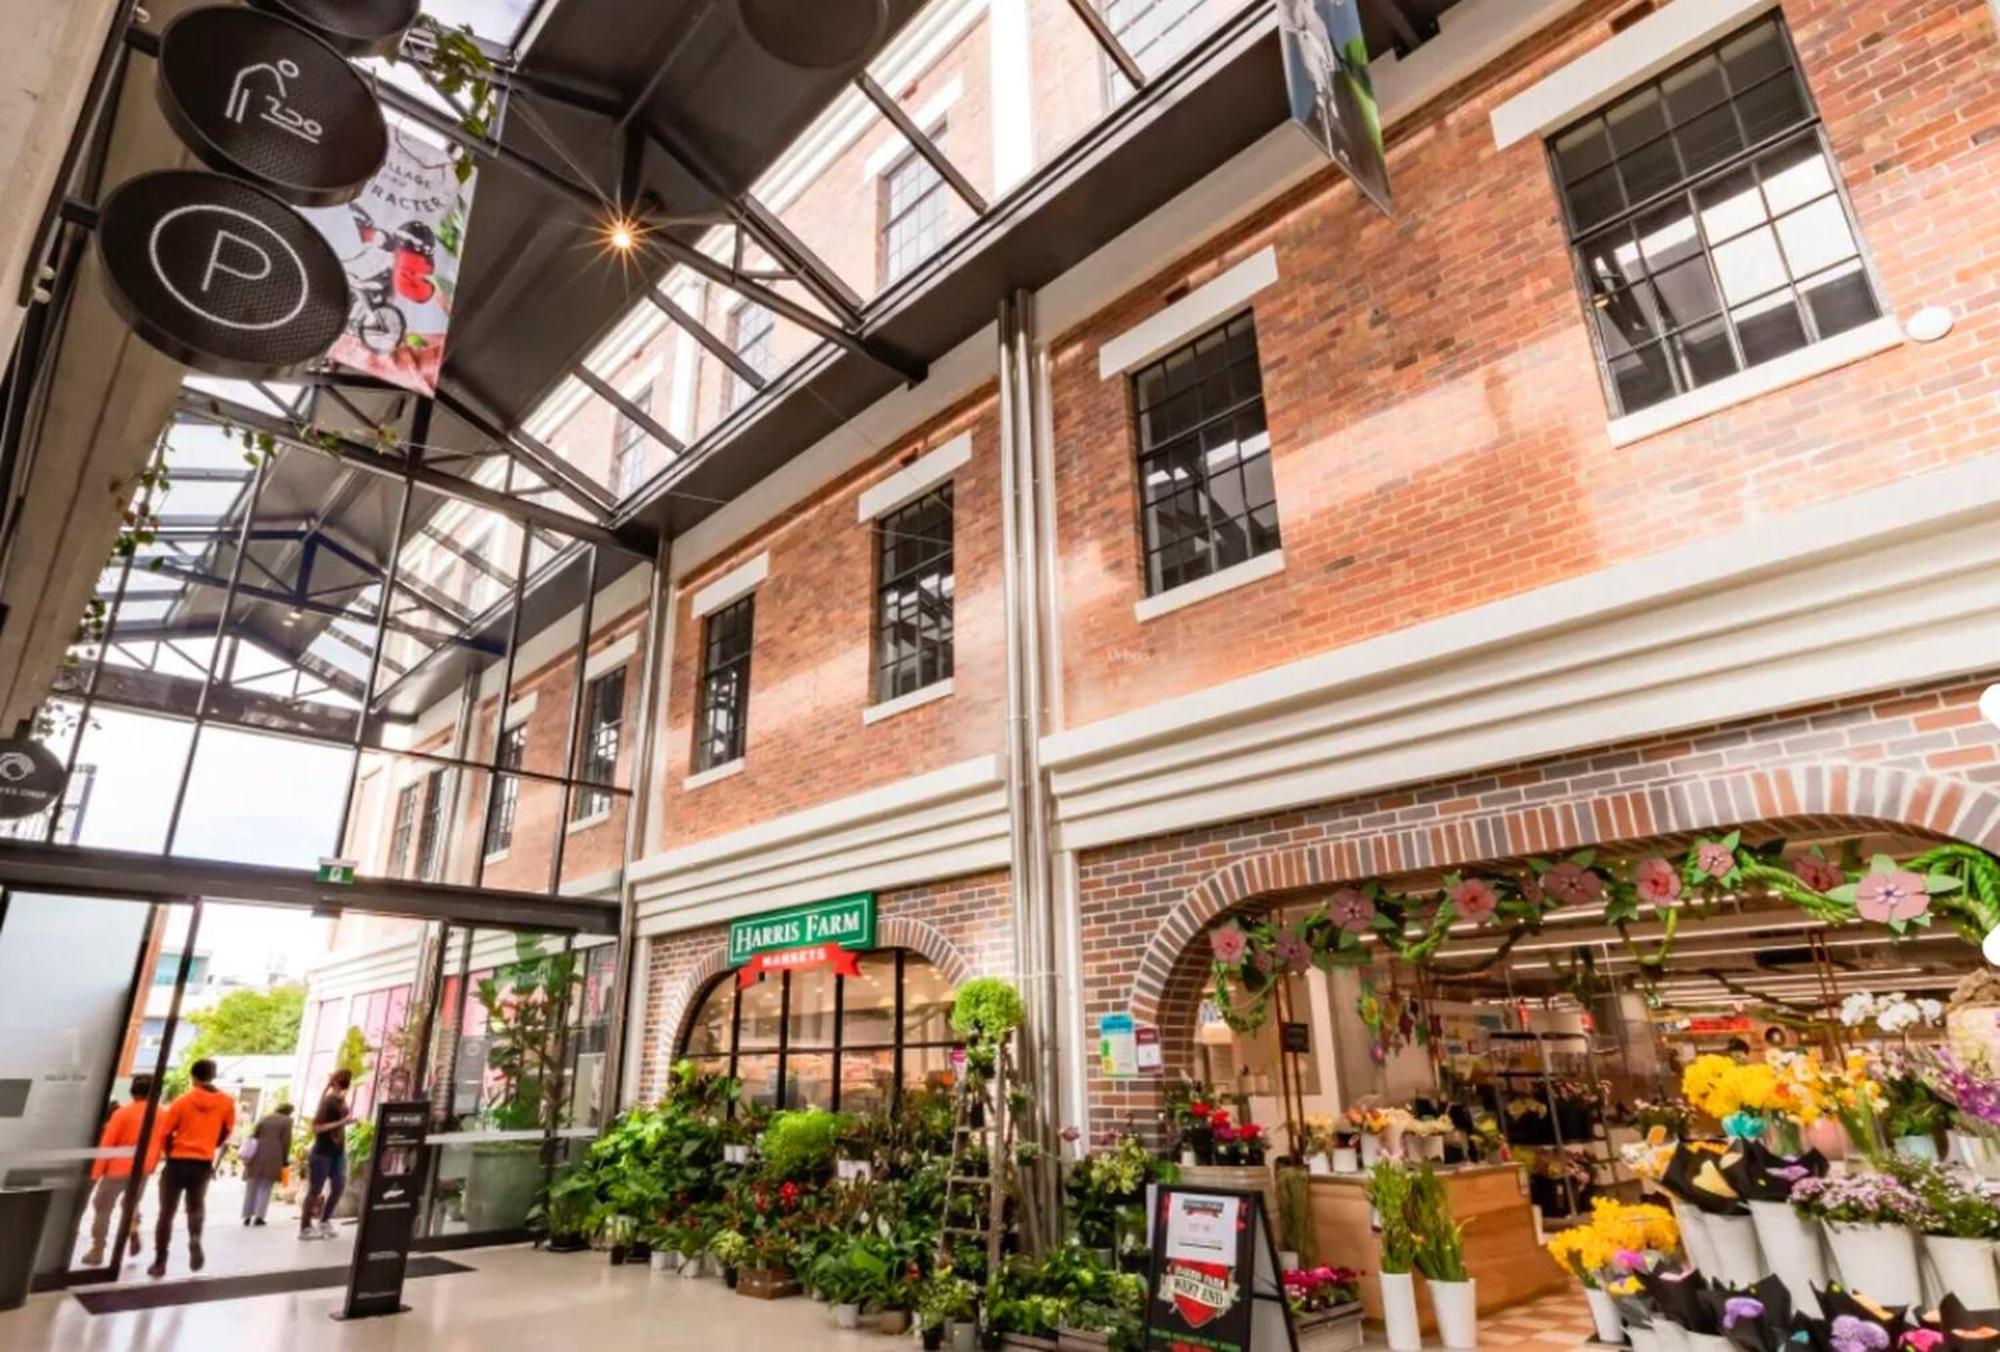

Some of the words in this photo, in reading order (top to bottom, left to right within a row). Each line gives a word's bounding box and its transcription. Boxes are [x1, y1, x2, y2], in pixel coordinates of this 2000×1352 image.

[388, 162, 432, 190] LLAGE
[371, 184, 446, 213] RACTER
[201, 229, 272, 292] P
[735, 919, 800, 954] HARRIS
[805, 910, 861, 942] FARM
[761, 947, 828, 967] MARKETS
